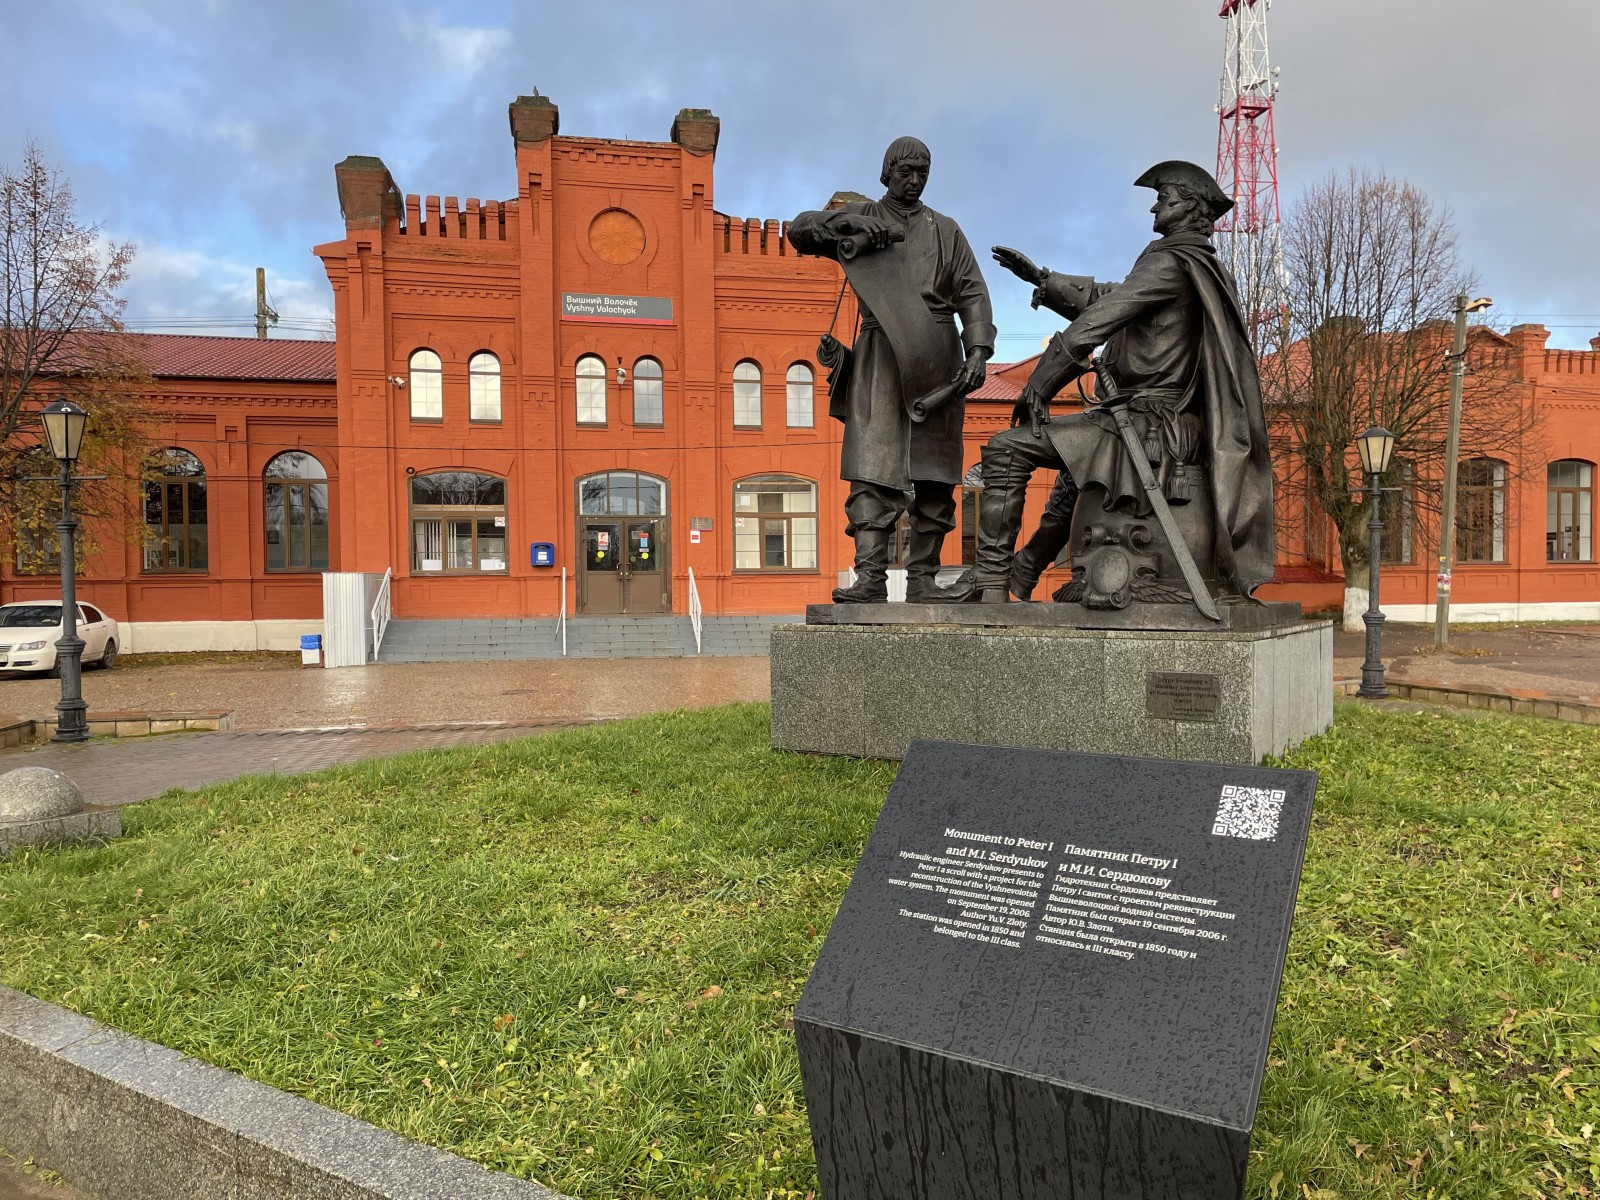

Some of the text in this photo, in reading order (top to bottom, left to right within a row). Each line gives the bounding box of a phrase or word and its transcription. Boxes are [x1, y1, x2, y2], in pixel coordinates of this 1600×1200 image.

[566, 296, 637, 306] Вышний Волочёк
[566, 304, 636, 315] Vyshny Volochyok
[944, 828, 1003, 845] Monument
[1004, 837, 1015, 846] to
[1016, 838, 1046, 850] Peter
[899, 851, 932, 861] Hydraulic
[933, 856, 964, 866] engineer
[965, 861, 1001, 872] Serdyukov
[1003, 868, 1035, 877] presents
[946, 846, 1048, 868] and M.I. Serdyukov
[1064, 844, 1129, 862] Памятник
[1130, 854, 1168, 869] Петру
[911, 872, 962, 885] reconstruction
[985, 883, 1038, 898] Vyshnevolotsk
[918, 863, 936, 872] Peter
[946, 868, 966, 876] scroll
[967, 870, 982, 879] with
[989, 875, 1015, 885] project
[1016, 878, 1027, 886] for
[1028, 880, 1041, 888] the
[1059, 863, 1171, 888] и М.И. Сердюкову
[908, 881, 934, 891] system.
[936, 885, 948, 893] The
[949, 889, 990, 901] monument
[991, 895, 1005, 903] was
[1006, 898, 1035, 908] opened
[1052, 884, 1077, 896] Петру
[1082, 890, 1111, 900] свиток
[1119, 896, 1162, 909] проектом
[1163, 902, 1236, 920] реконструкции
[1055, 875, 1218, 906] Гидротехник Сердюков представляет
[957, 899, 998, 912] September
[999, 906, 1008, 915] 19,
[1010, 908, 1030, 918] 2006.
[960, 910, 1027, 928] Author Yu.V. Zloty.
[1049, 893, 1197, 924] Вышневолоцкой водной системы.
[899, 909, 912, 917] The
[913, 912, 938, 921] station
[953, 920, 981, 931] opened
[991, 925, 1009, 934] 1850
[1010, 930, 1025, 938] and
[1042, 914, 1114, 933] Автор Ю.В. Злоти.
[1045, 904, 1089, 918] Памятник
[1089, 911, 1107, 921] был
[1108, 915, 1141, 927] открыт
[1142, 920, 1152, 928] 19
[1153, 923, 1195, 936] сентября
[1196, 930, 1220, 940] 2006
[934, 925, 968, 938] belonged
[977, 934, 989, 942] the
[990, 936, 1000, 944] III
[1001, 938, 1021, 948] class.
[1035, 934, 1085, 949] относилась
[1092, 944, 1102, 953] III
[1103, 947, 1135, 960] классу.
[1039, 924, 1075, 938] Станция
[1076, 929, 1099, 940] была
[1100, 935, 1138, 948] открыта
[1145, 943, 1166, 953] 1850
[1167, 948, 1188, 958] году
